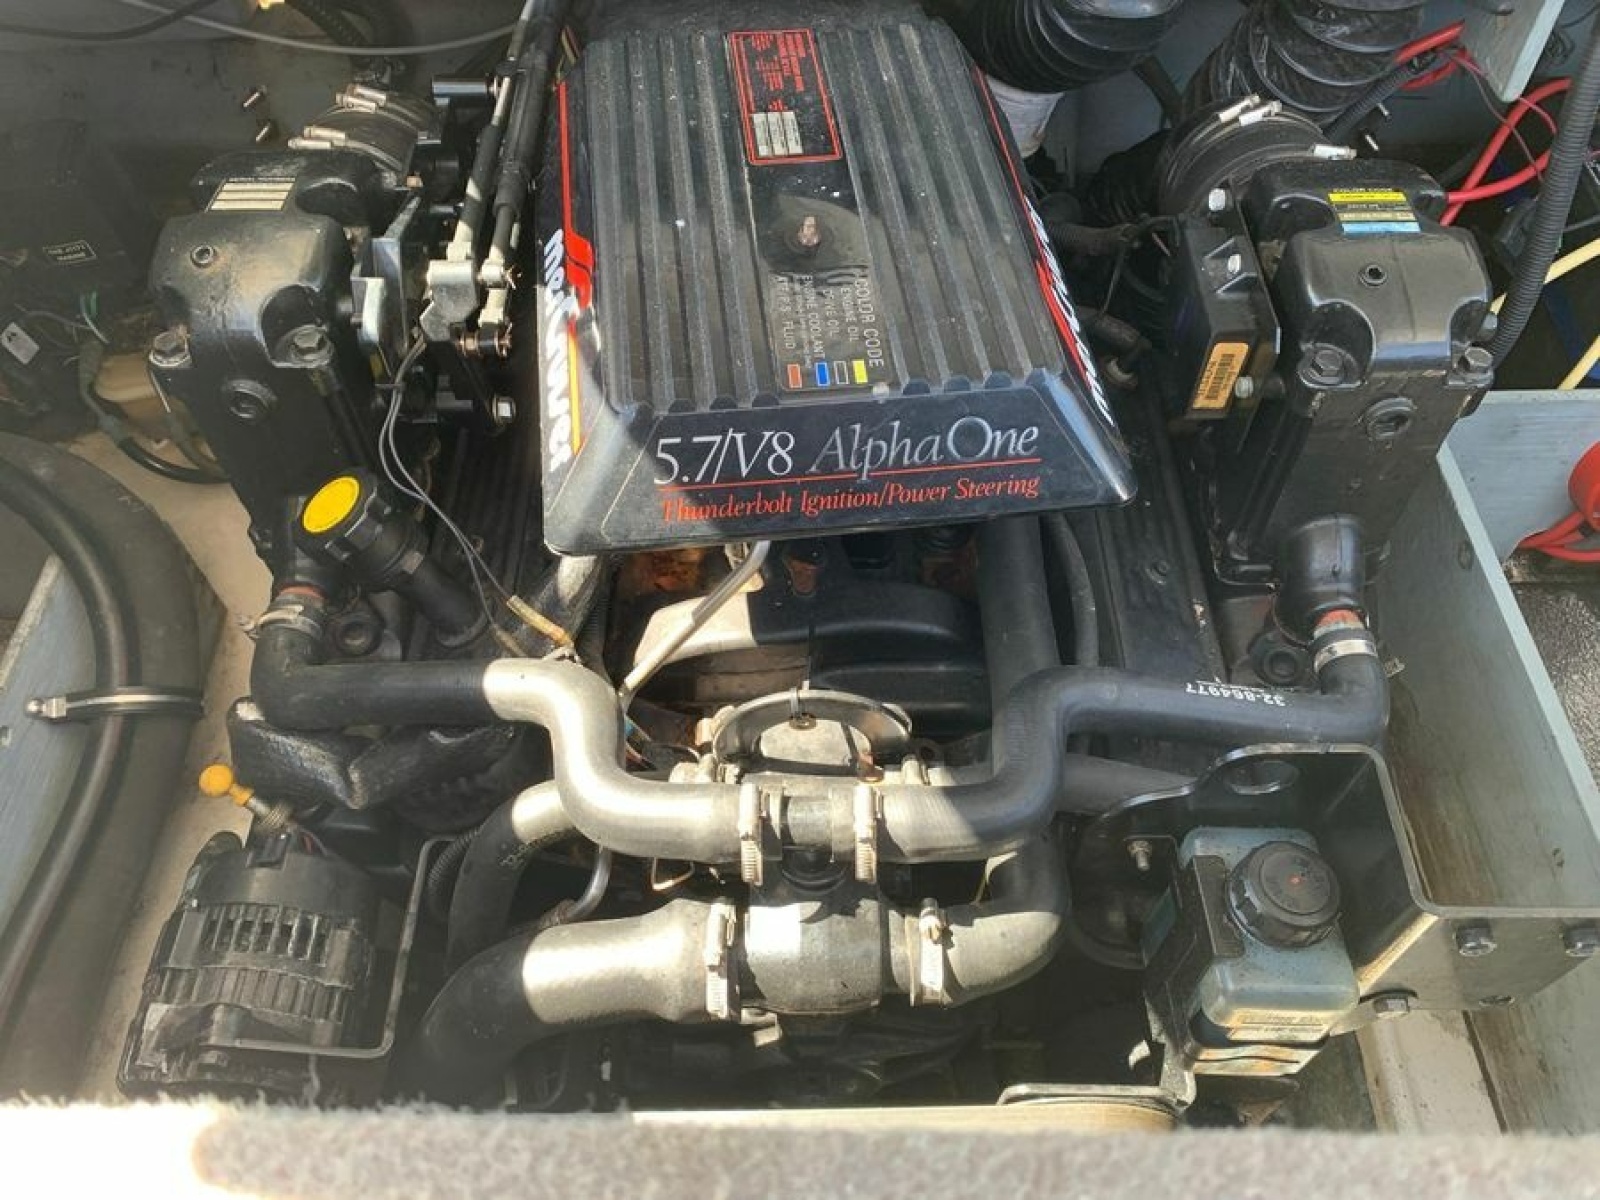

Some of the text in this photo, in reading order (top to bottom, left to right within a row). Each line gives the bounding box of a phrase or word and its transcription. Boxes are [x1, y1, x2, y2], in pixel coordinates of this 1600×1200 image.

[808, 312, 825, 359] COOLANT
[848, 326, 859, 342] OIL
[854, 278, 884, 367] COLOR CODE
[662, 475, 1041, 523] Thunderbolt Ignition/Power Steering
